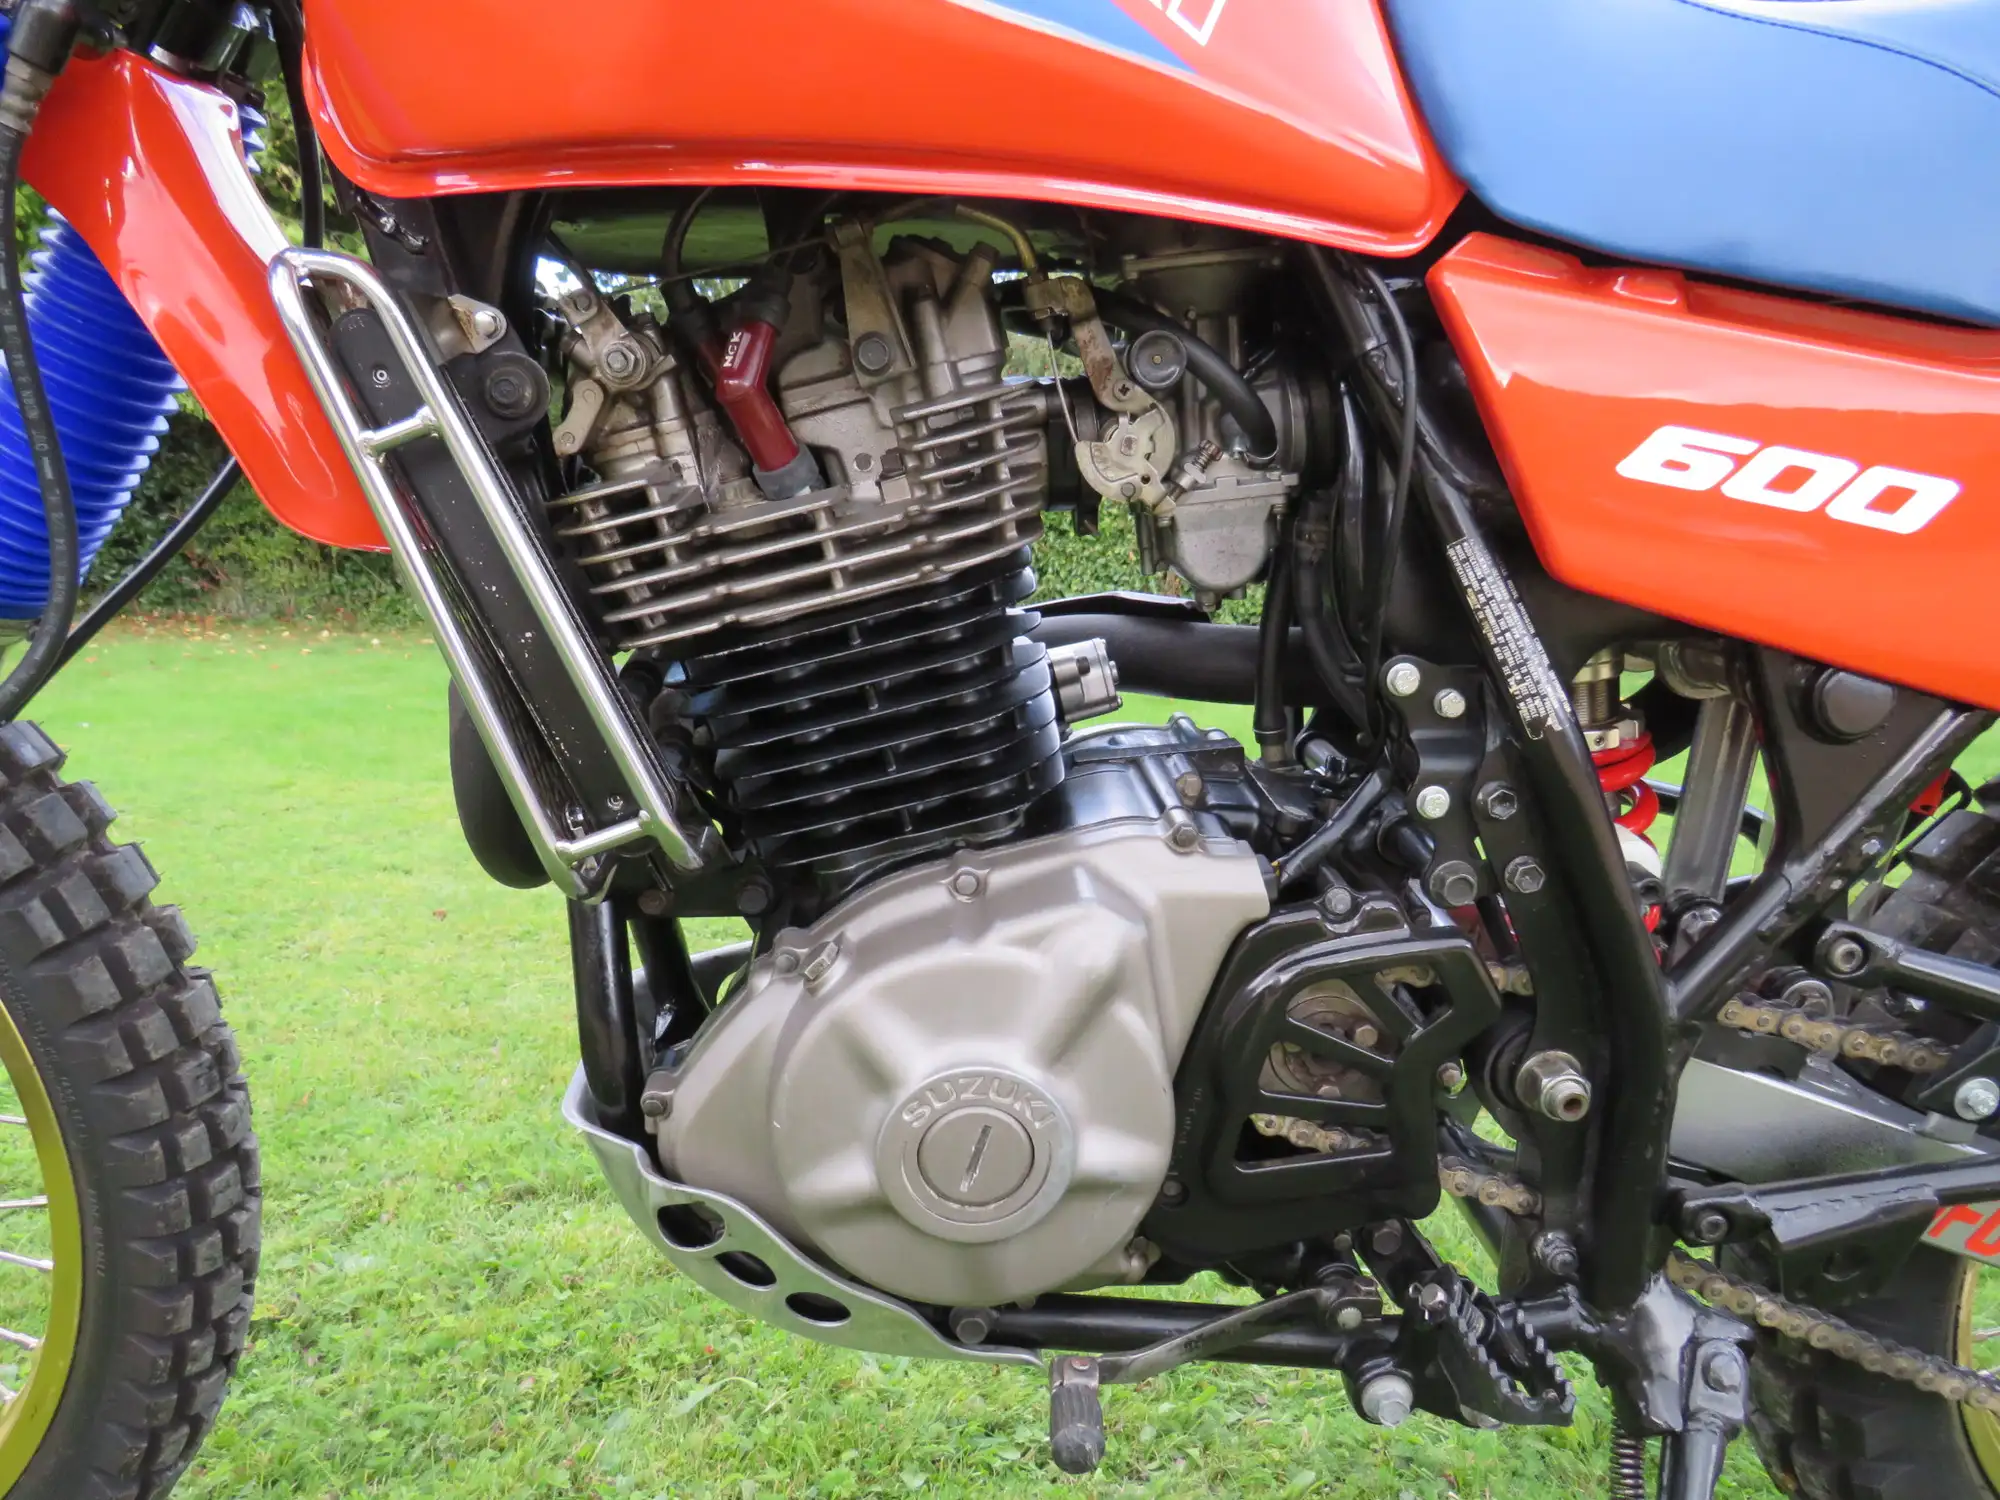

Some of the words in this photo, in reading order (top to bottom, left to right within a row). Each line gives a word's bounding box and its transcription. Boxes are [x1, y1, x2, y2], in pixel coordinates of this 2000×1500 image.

[1615, 424, 1961, 535] 600
[1454, 543, 1466, 560] NOISE
[1462, 561, 1481, 591] STANDARDS
[1500, 645, 1515, 667] FEDERAL
[1488, 599, 1501, 616] CAUSE
[1496, 617, 1507, 630] THIS
[1503, 631, 1523, 664] MOTORCYCLE
[1532, 637, 1550, 667] CONTROL
[902, 1076, 1057, 1129] SUZUKI
